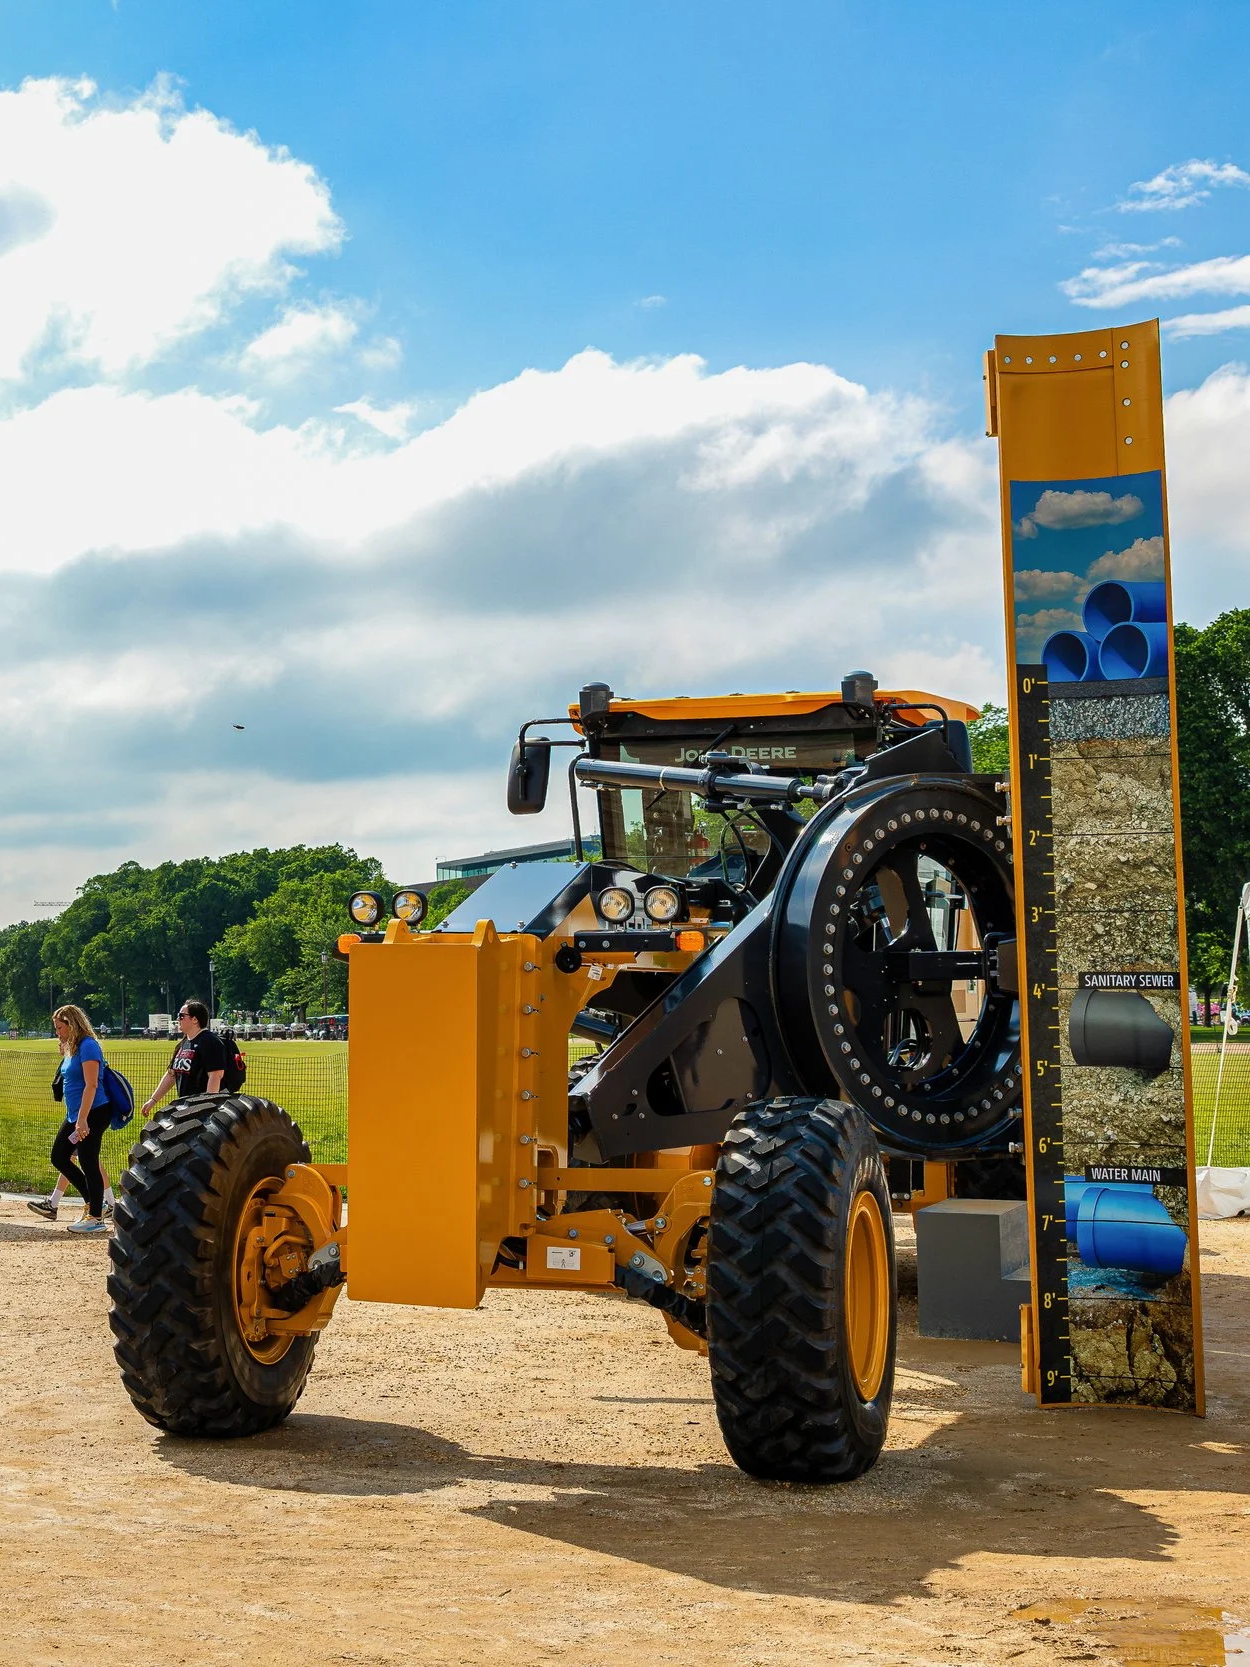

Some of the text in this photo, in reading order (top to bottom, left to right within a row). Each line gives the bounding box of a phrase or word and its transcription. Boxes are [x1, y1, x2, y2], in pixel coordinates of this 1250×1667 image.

[1023, 677, 1035, 694] 0'
[731, 745, 797, 760] DEERE
[1028, 753, 1038, 769] 1'
[1029, 829, 1040, 846] 2'
[1031, 906, 1043, 923] 3'
[1084, 973, 1174, 988] SANITARY SEWER
[1033, 983, 1045, 999] 4'
[1037, 1060, 1048, 1077] 5'
[1039, 1137, 1050, 1154] 6'
[1091, 1167, 1161, 1183] WATER MAIN
[1042, 1215, 1053, 1231] 7'
[1044, 1292, 1056, 1309] 8'
[1047, 1370, 1058, 1387] 9'
